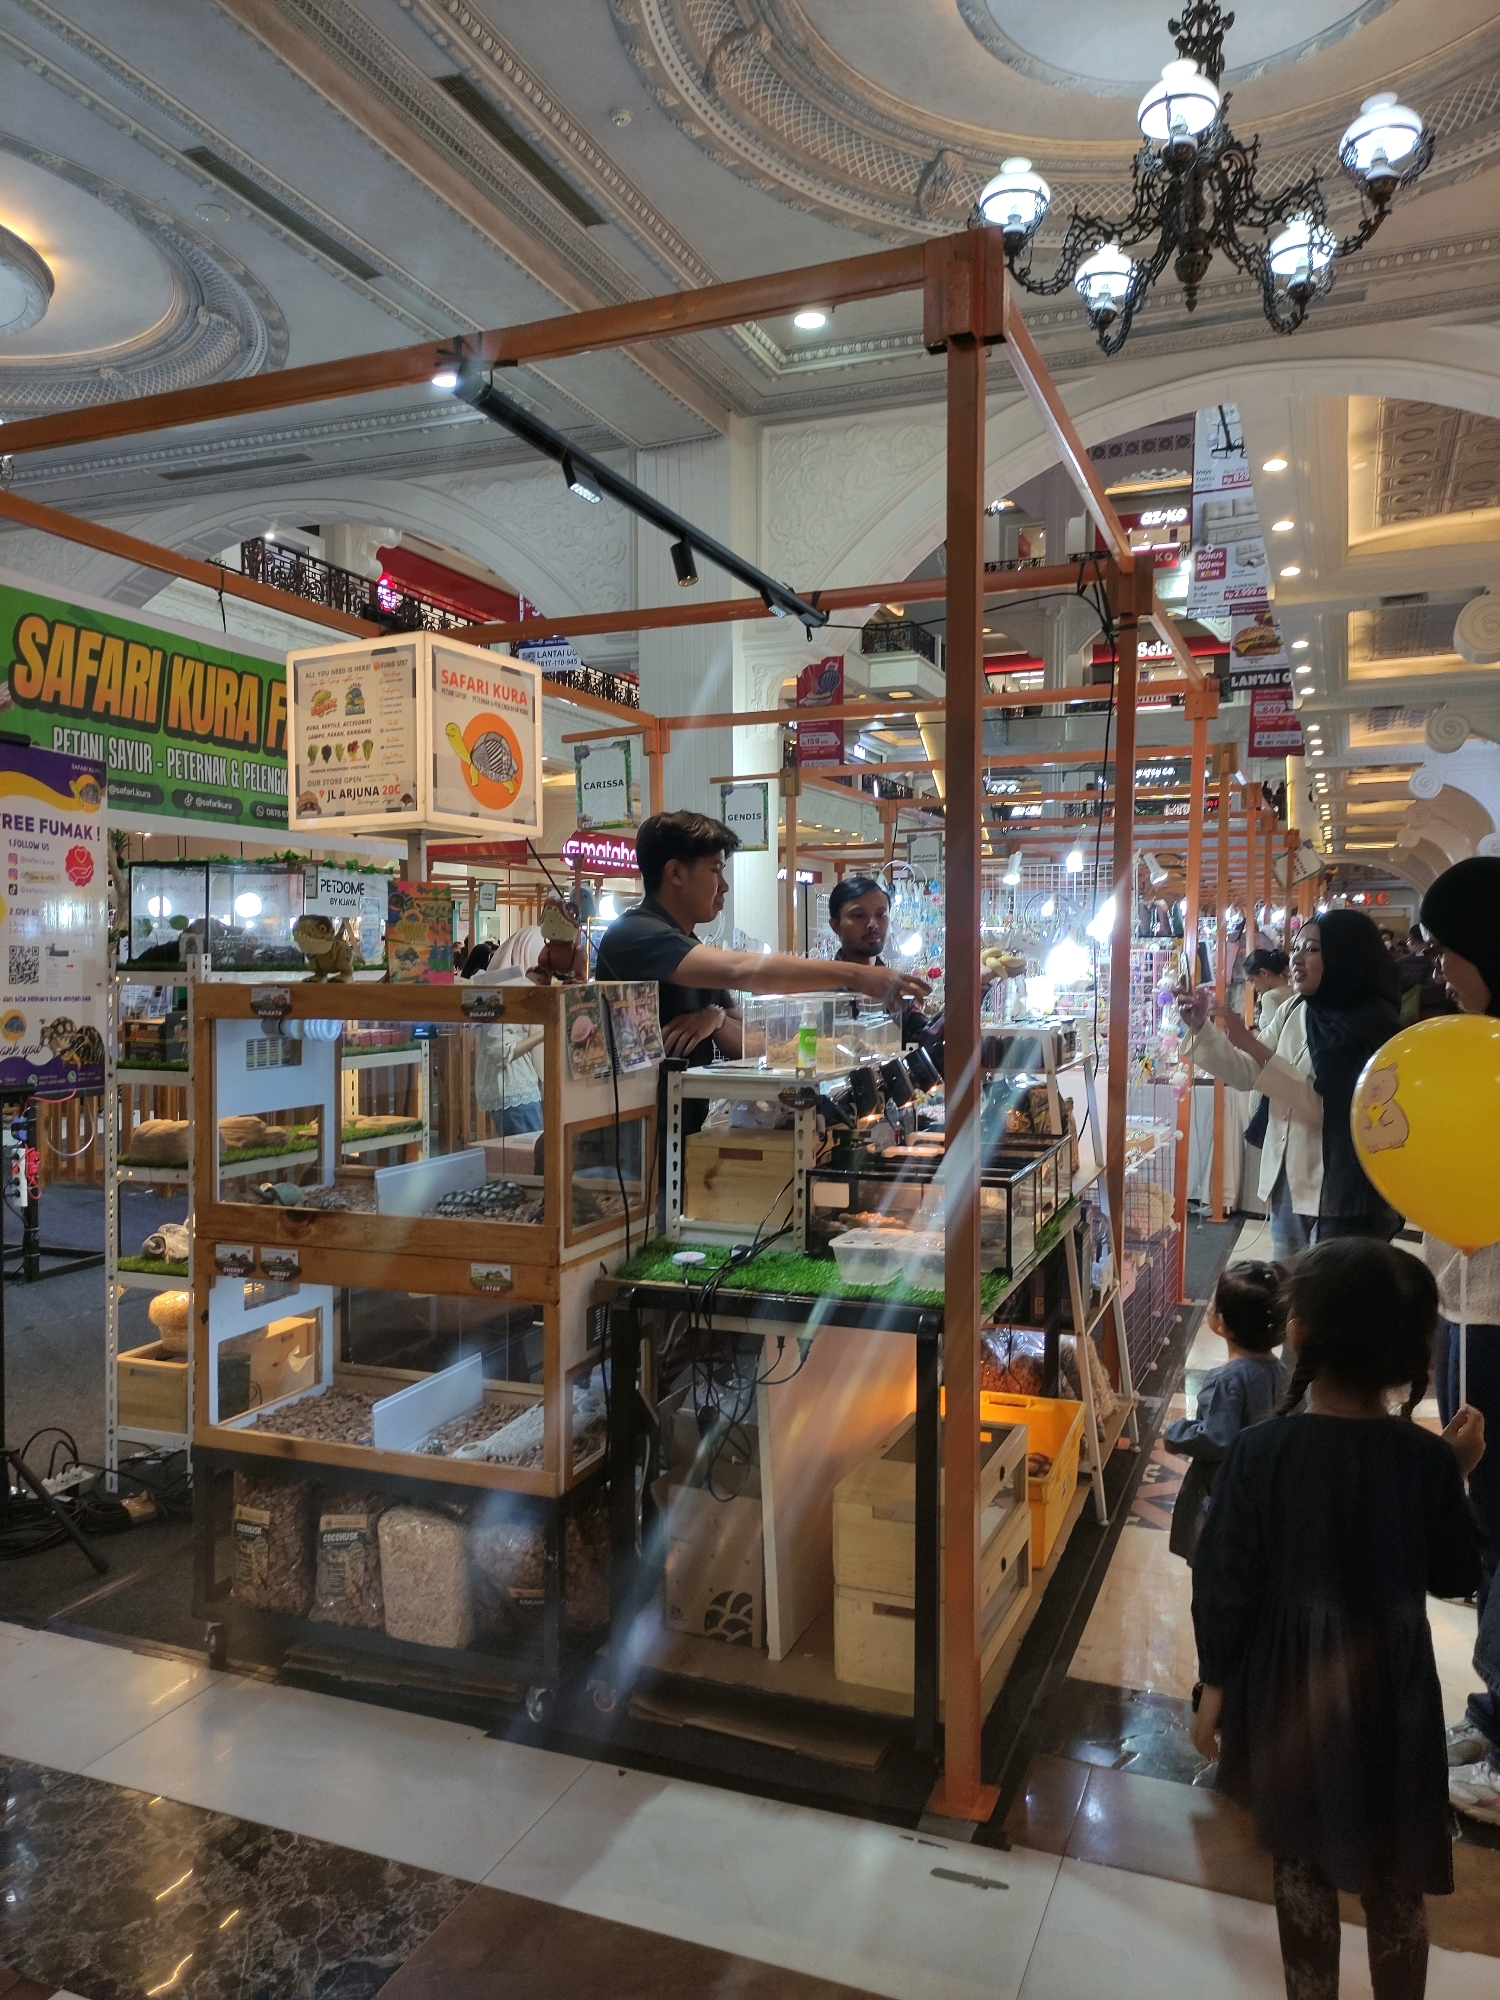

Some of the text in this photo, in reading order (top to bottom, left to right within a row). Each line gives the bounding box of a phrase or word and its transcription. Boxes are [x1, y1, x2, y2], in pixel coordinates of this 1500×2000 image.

[1197, 551, 1223, 561] BONUS
[1196, 561, 1211, 571] 100
[536, 649, 565, 659] LANTAI
[380, 659, 409, 669] FIND US?
[317, 669, 330, 677] YOU
[354, 664, 371, 672] HERE!
[10, 614, 288, 752] SAFARI KURA F
[1230, 672, 1280, 688] LANTAI
[441, 669, 528, 706] SAFARI KURA
[1262, 706, 1281, 715] 849
[53, 726, 104, 763] PETANI
[108, 736, 153, 774] SAYUR
[166, 747, 229, 786] PETERNAK
[230, 759, 240, 785] &
[307, 779, 321, 787] OUR
[322, 777, 342, 786] STORE
[343, 776, 362, 784] OPEN
[583, 779, 624, 790] CARISSA
[326, 783, 401, 803] JL ARJUNA 20C
[727, 812, 762, 821] GENDIS
[39, 817, 93, 841] FUMAK
[41, 842, 50, 851] US
[320, 878, 365, 896] PETDOME
[329, 897, 338, 906] BY
[236, 1522, 263, 1535] COCOHUSK
[322, 1531, 359, 1543] COCOHUSK
